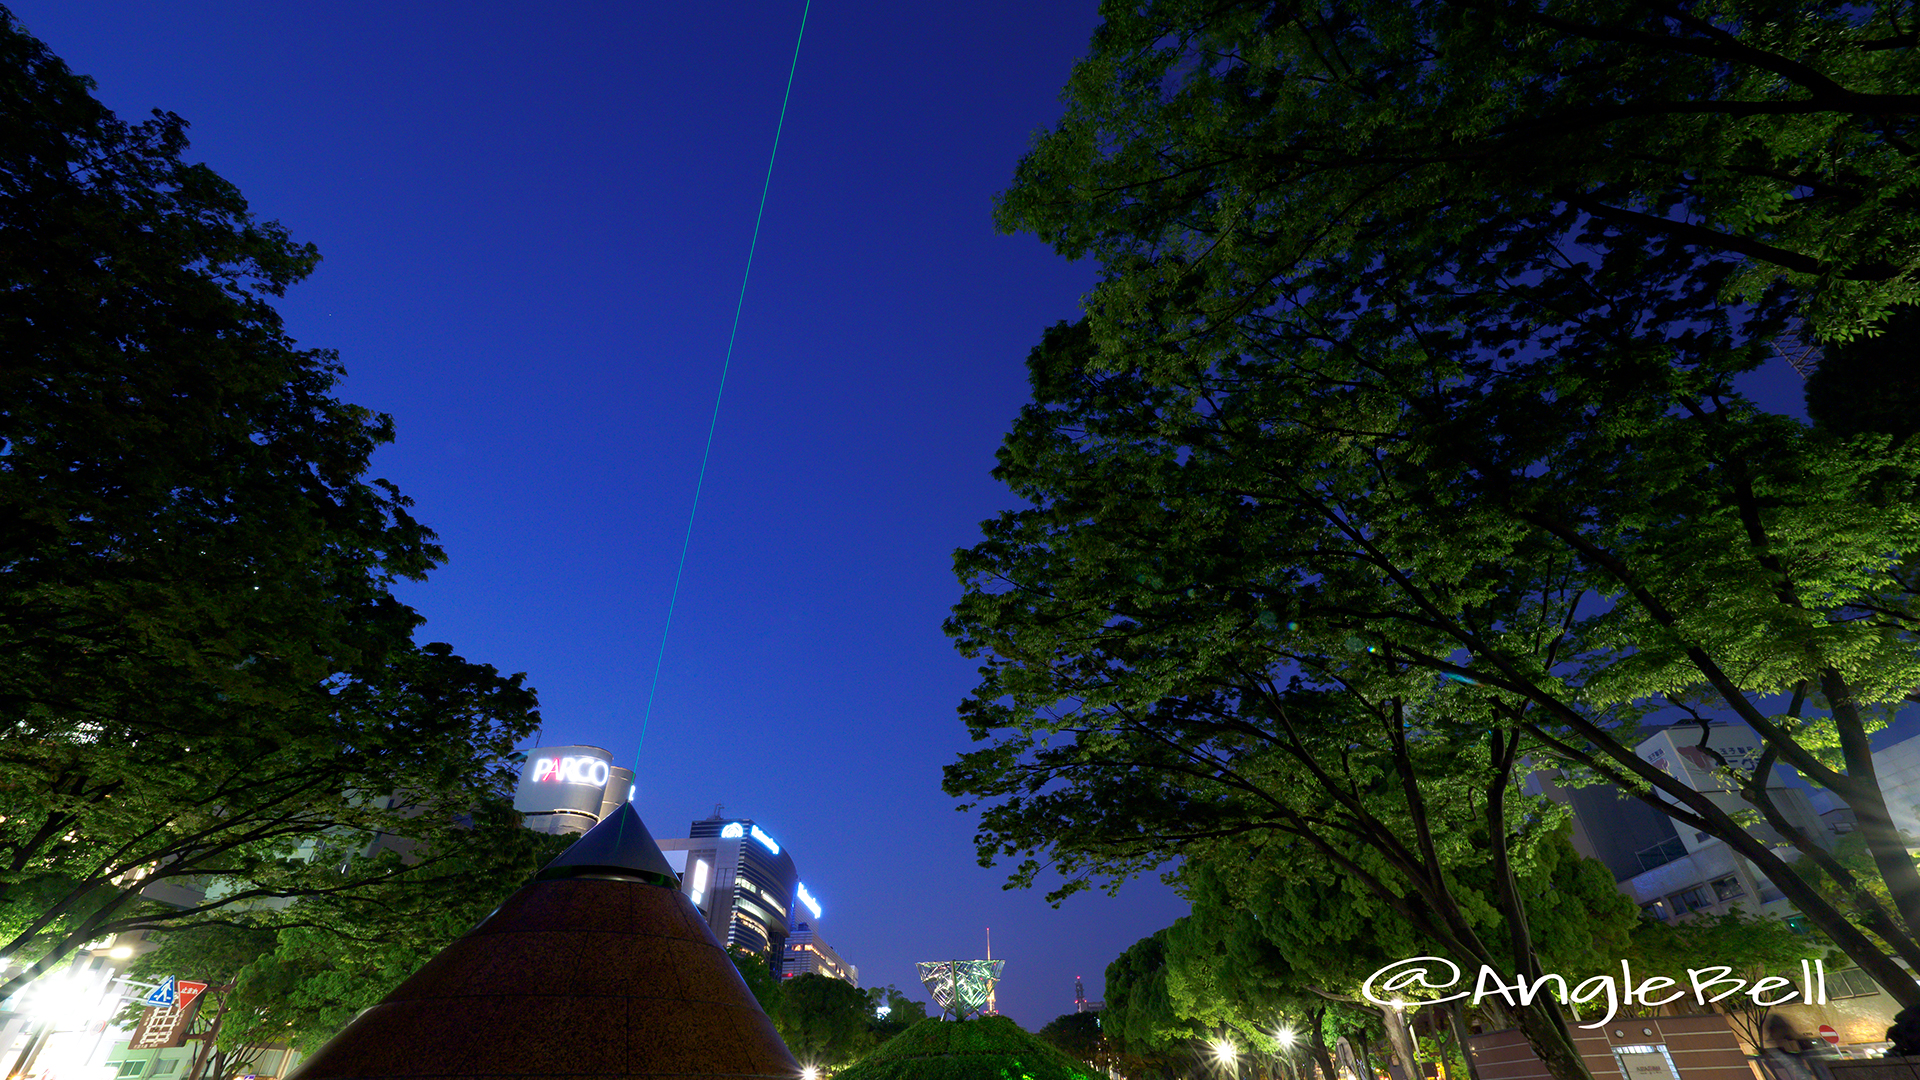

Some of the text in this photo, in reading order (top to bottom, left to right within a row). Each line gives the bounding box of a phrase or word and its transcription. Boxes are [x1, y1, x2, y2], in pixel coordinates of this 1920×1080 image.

[532, 757, 609, 786] PARCO
[180, 987, 199, 995] 止まれ
